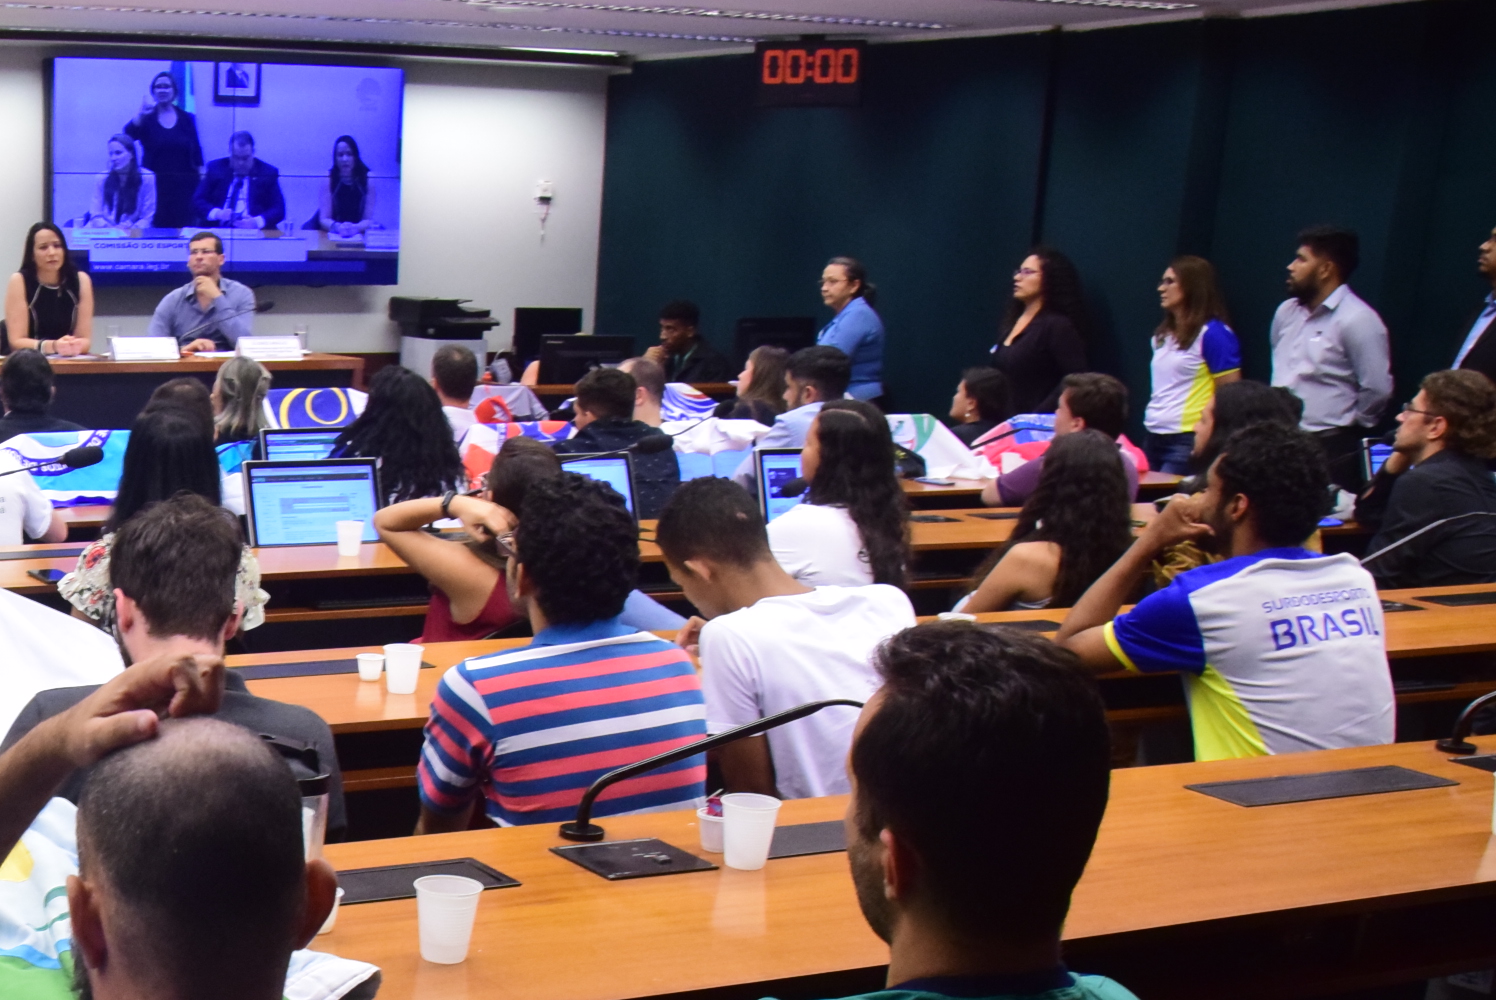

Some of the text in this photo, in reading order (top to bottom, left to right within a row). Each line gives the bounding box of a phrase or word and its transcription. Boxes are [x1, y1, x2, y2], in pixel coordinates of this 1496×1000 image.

[762, 48, 858, 84] 00:00
[94, 241, 139, 249] COMISSÃO
[1270, 606, 1380, 651] BRASIL
